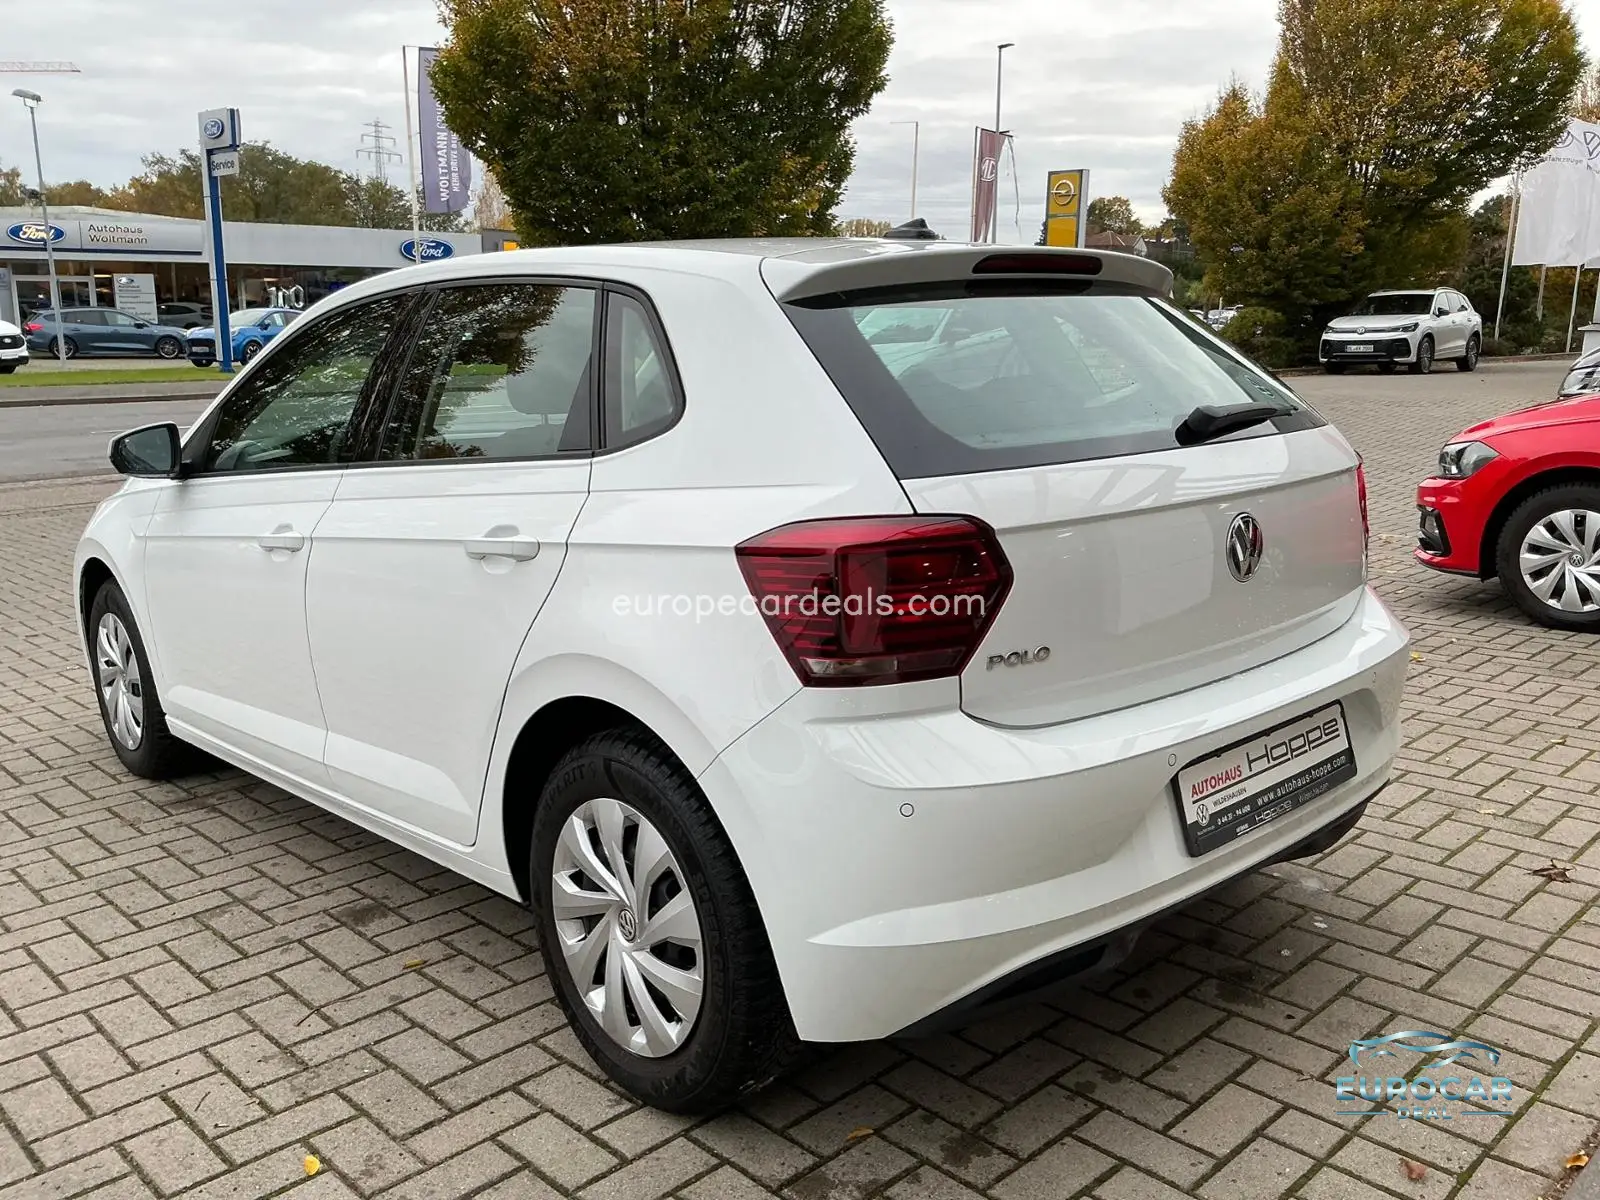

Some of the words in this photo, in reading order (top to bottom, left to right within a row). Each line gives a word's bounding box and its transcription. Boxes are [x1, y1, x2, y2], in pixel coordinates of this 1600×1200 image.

[211, 160, 235, 171] Service
[436, 131, 450, 202] WOLTMANN
[450, 150, 459, 172] DRIVE
[88, 223, 143, 234] Autohaus
[88, 234, 148, 244] Woltmann
[986, 646, 1051, 672] POLO
[1191, 765, 1243, 798] AUTOHAUS
[1246, 717, 1341, 773] Hoppe
[1256, 755, 1346, 806] www.autohaus-hoppe.com
